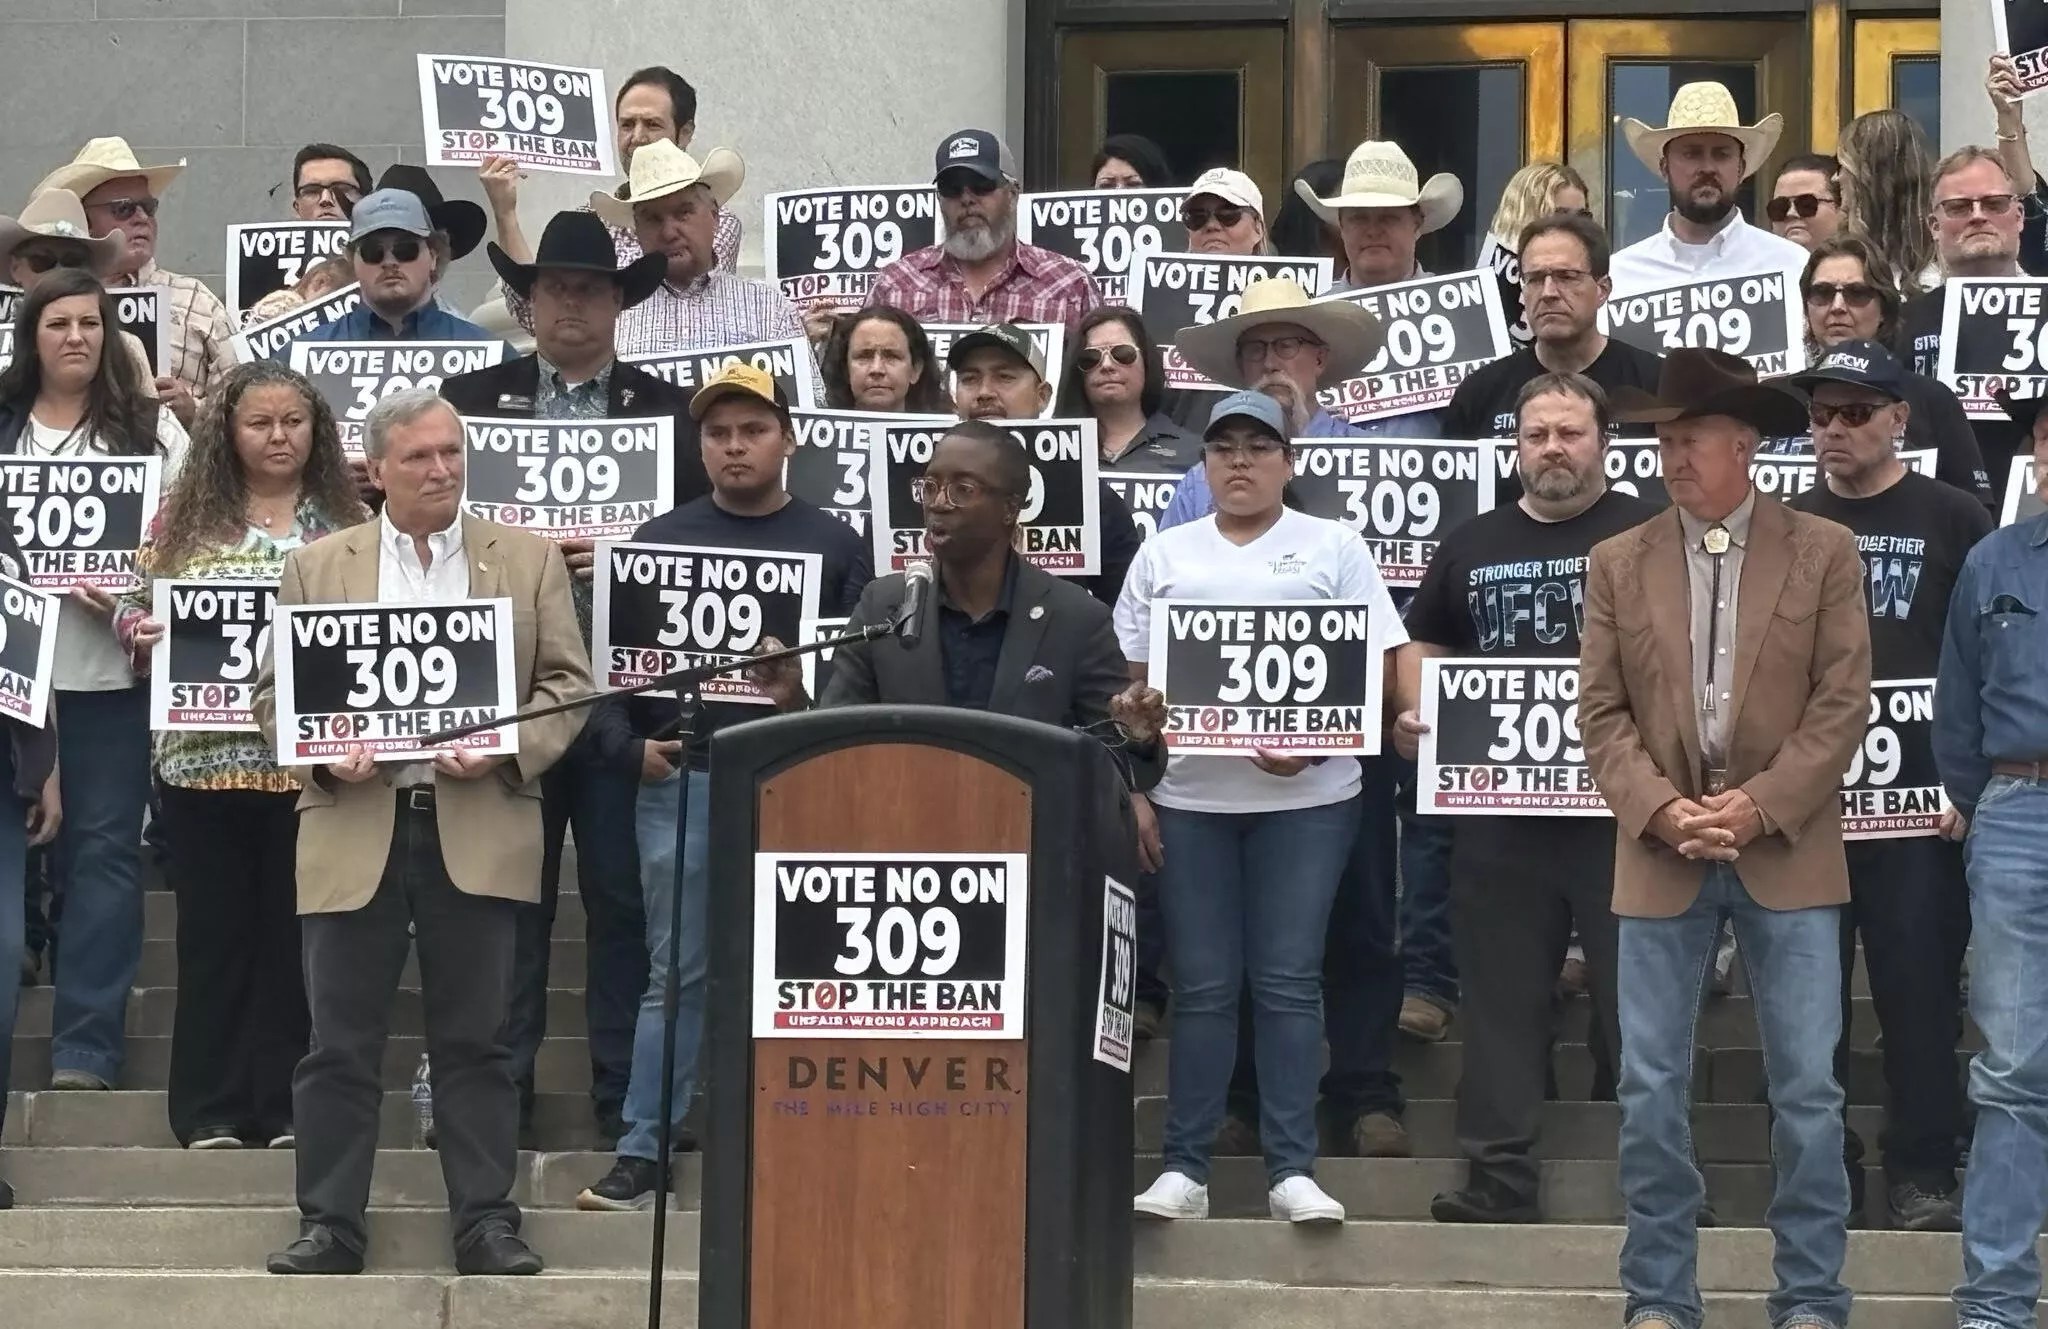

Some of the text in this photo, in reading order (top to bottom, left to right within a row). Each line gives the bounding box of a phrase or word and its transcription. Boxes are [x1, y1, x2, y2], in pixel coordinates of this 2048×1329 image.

[433, 62, 591, 97] VOTE NO ON
[477, 87, 565, 135] 309
[442, 131, 596, 158] STOP THE BAN
[778, 194, 934, 225] VOTE NO ON
[1033, 200, 1100, 227] VOTE
[1109, 198, 1148, 223] NO
[241, 231, 350, 257] VOTE NO
[813, 221, 902, 269] 309
[1147, 262, 1220, 291] VOTE
[1495, 247, 1520, 284] VO
[780, 275, 876, 298] STOP TH
[1387, 289, 1431, 319] NO
[1438, 279, 1482, 309] ON
[1609, 275, 1782, 327] VOTE NO ON
[1963, 288, 2041, 314] VOTE
[118, 298, 155, 323] ON
[249, 321, 319, 361] VOTE
[1362, 315, 1455, 372] 09
[308, 350, 487, 374] VOTE NO ON
[641, 361, 694, 387] TE
[751, 349, 793, 376] ON
[1756, 352, 1786, 373] AN
[1318, 380, 1383, 406] STOP
[1390, 367, 1439, 394] THE
[1956, 375, 2021, 398] STOP
[468, 426, 656, 453] VOTE NO ON
[793, 419, 870, 450] VOTE
[888, 432, 944, 463] VO
[1035, 431, 1079, 461] ON
[515, 455, 620, 503] 309
[1294, 448, 1370, 476] VOTE
[1379, 449, 1424, 478] NO
[1432, 450, 1476, 480] ON
[0, 465, 144, 494] TE NO ON
[1134, 482, 1176, 509] NO
[1338, 480, 1440, 536] 309
[6, 496, 106, 547] 309
[470, 502, 654, 526] STOP THE BAN
[893, 528, 1081, 553] ST BAN
[30, 552, 136, 573] THE BAN
[612, 552, 801, 593] VOTE NO ON
[1469, 556, 1590, 586] STRONGER TOGET
[4, 588, 44, 627] ON
[172, 590, 256, 620] VOTE
[293, 610, 494, 647] VOTE NO ON
[657, 590, 762, 651] 309
[1170, 610, 1365, 641] VOTE NO ON
[611, 649, 676, 673] STOP
[1217, 644, 1327, 702] 309
[0, 672, 32, 701] AN
[347, 646, 457, 707] 309
[1441, 669, 1579, 700] VOTE NO
[172, 684, 240, 708] STOP
[1889, 690, 1933, 721] ON
[299, 714, 369, 740] STOP
[377, 711, 430, 736] THE
[1168, 708, 1361, 732] STOP THE BAN
[1488, 703, 1585, 762] 309
[1282, 736, 1353, 746] APPROACH
[1439, 767, 1568, 792] STOP THE
[1552, 797, 1607, 807] APPROA
[1841, 788, 1941, 816] HE BAN
[778, 867, 1004, 903] VOTE NO ON
[834, 906, 960, 976] 309
[778, 981, 1000, 1010] STOP THE BAN
[909, 1016, 991, 1028] APPROACH
[789, 1056, 1012, 1091] DENVER
[774, 1102, 1011, 1116] THE MILE HIGH CITY
